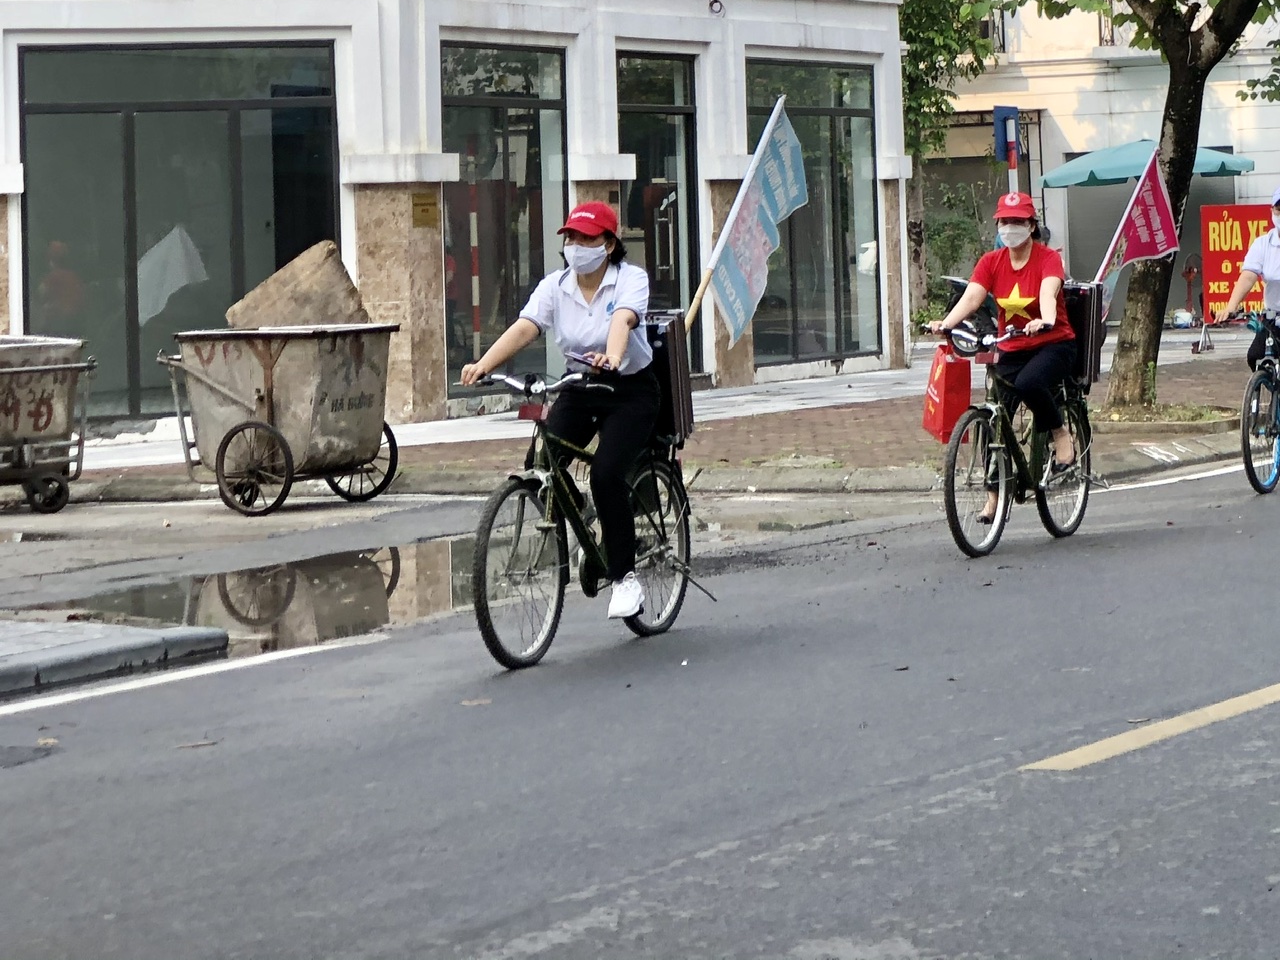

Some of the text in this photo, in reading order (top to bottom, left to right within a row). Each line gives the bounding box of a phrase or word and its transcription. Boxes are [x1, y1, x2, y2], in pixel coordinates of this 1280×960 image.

[1208, 210, 1243, 251] RỬA
[1221, 260, 1232, 274] Ô
[1208, 281, 1230, 293] XE
